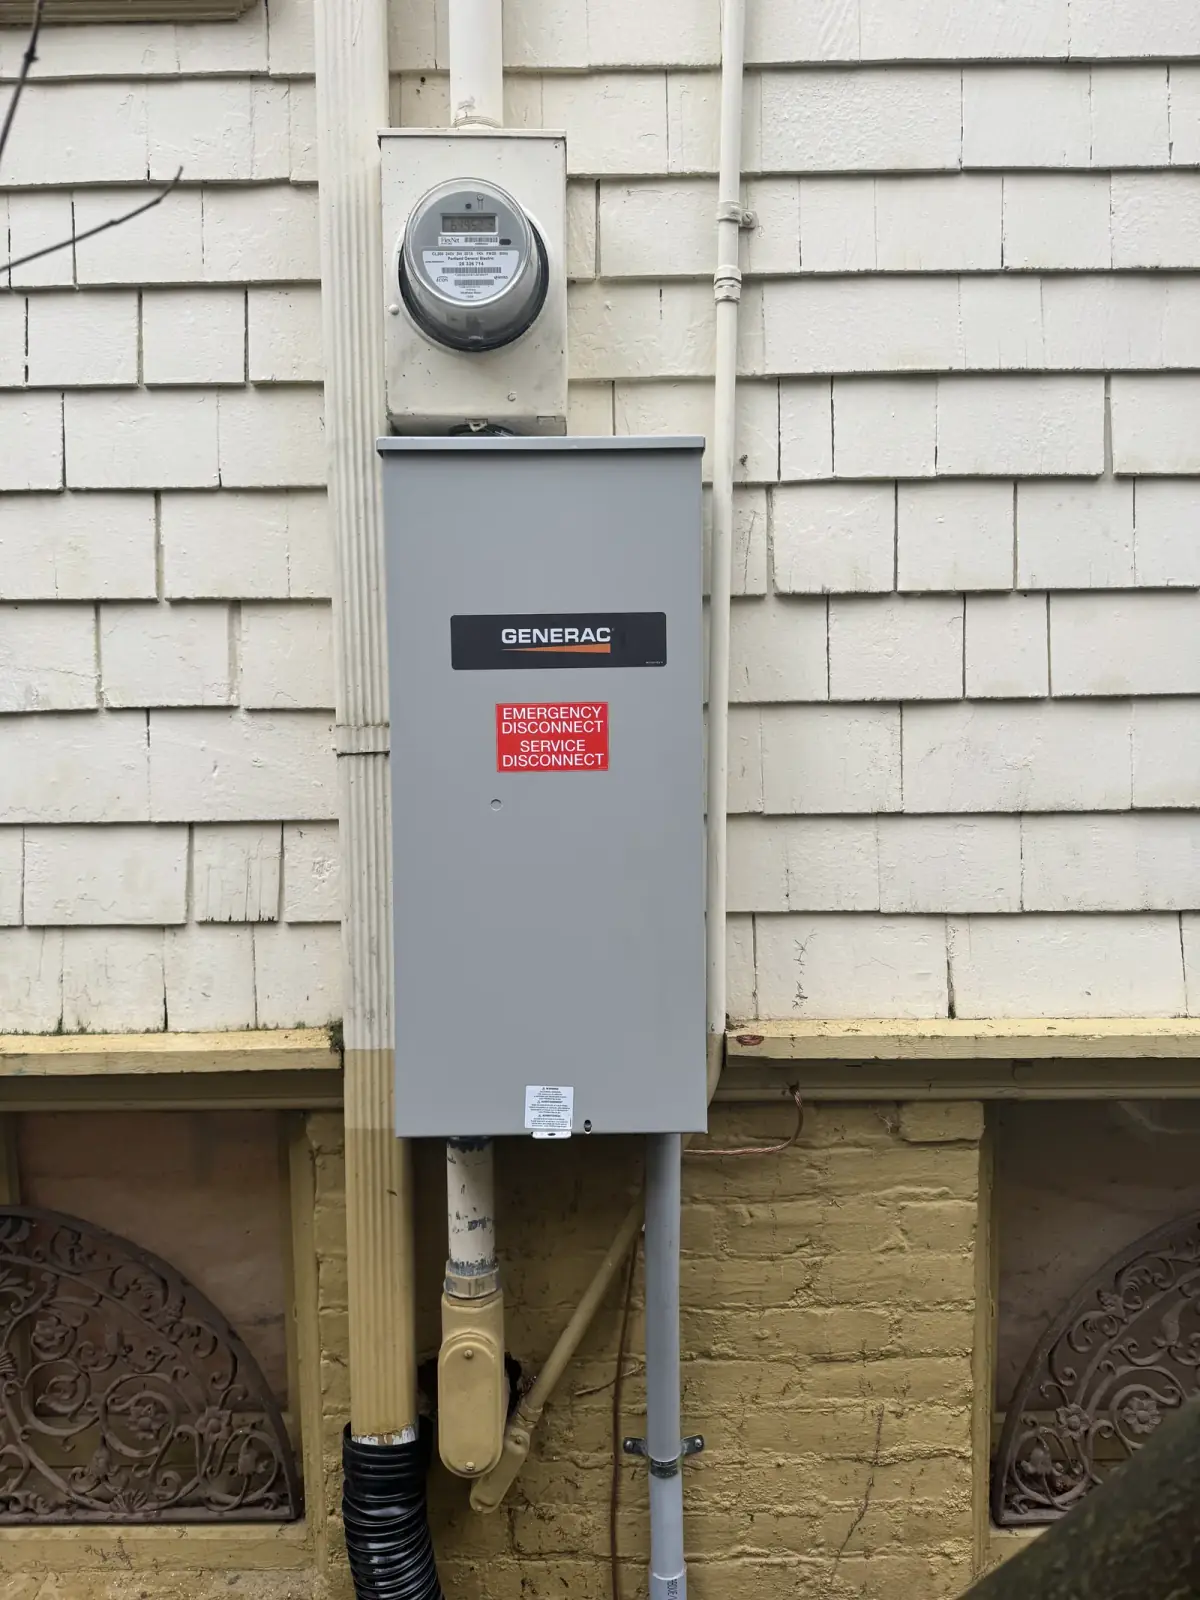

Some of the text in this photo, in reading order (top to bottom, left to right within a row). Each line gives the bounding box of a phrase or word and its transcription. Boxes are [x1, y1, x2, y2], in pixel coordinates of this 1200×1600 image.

[501, 627, 611, 644] GENERAC
[503, 706, 602, 720] EMERGENCY
[502, 720, 604, 734] DISCONNECT
[520, 739, 586, 752] SERVICE
[502, 753, 605, 767] DISCONNECT
